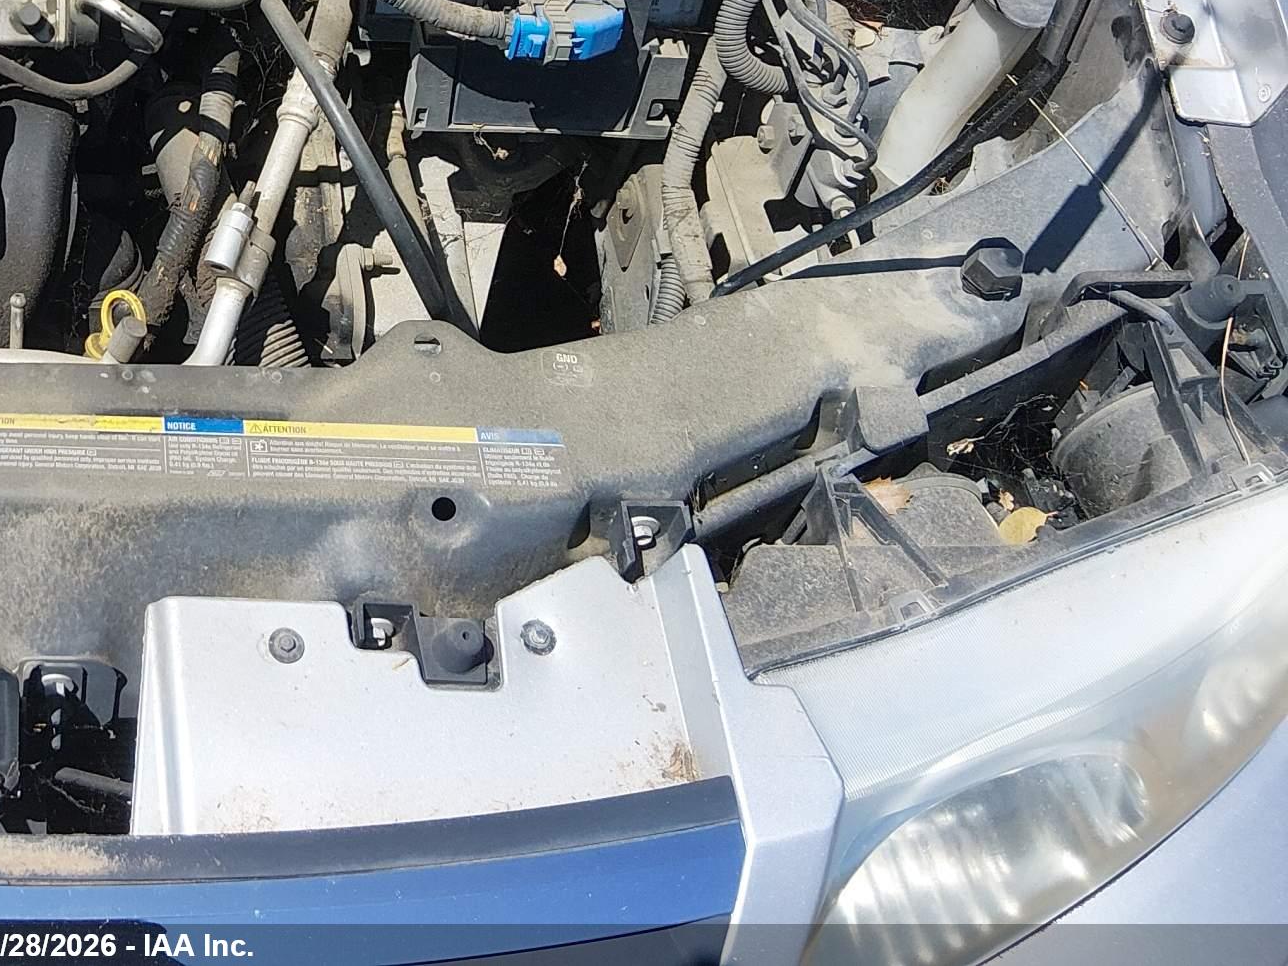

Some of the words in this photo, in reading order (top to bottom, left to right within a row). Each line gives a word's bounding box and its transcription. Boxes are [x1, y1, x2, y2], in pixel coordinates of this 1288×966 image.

[556, 353, 578, 364] GND
[166, 421, 197, 430] NOTICE
[263, 425, 306, 434] ATTENTION
[480, 432, 500, 440] AVIS
